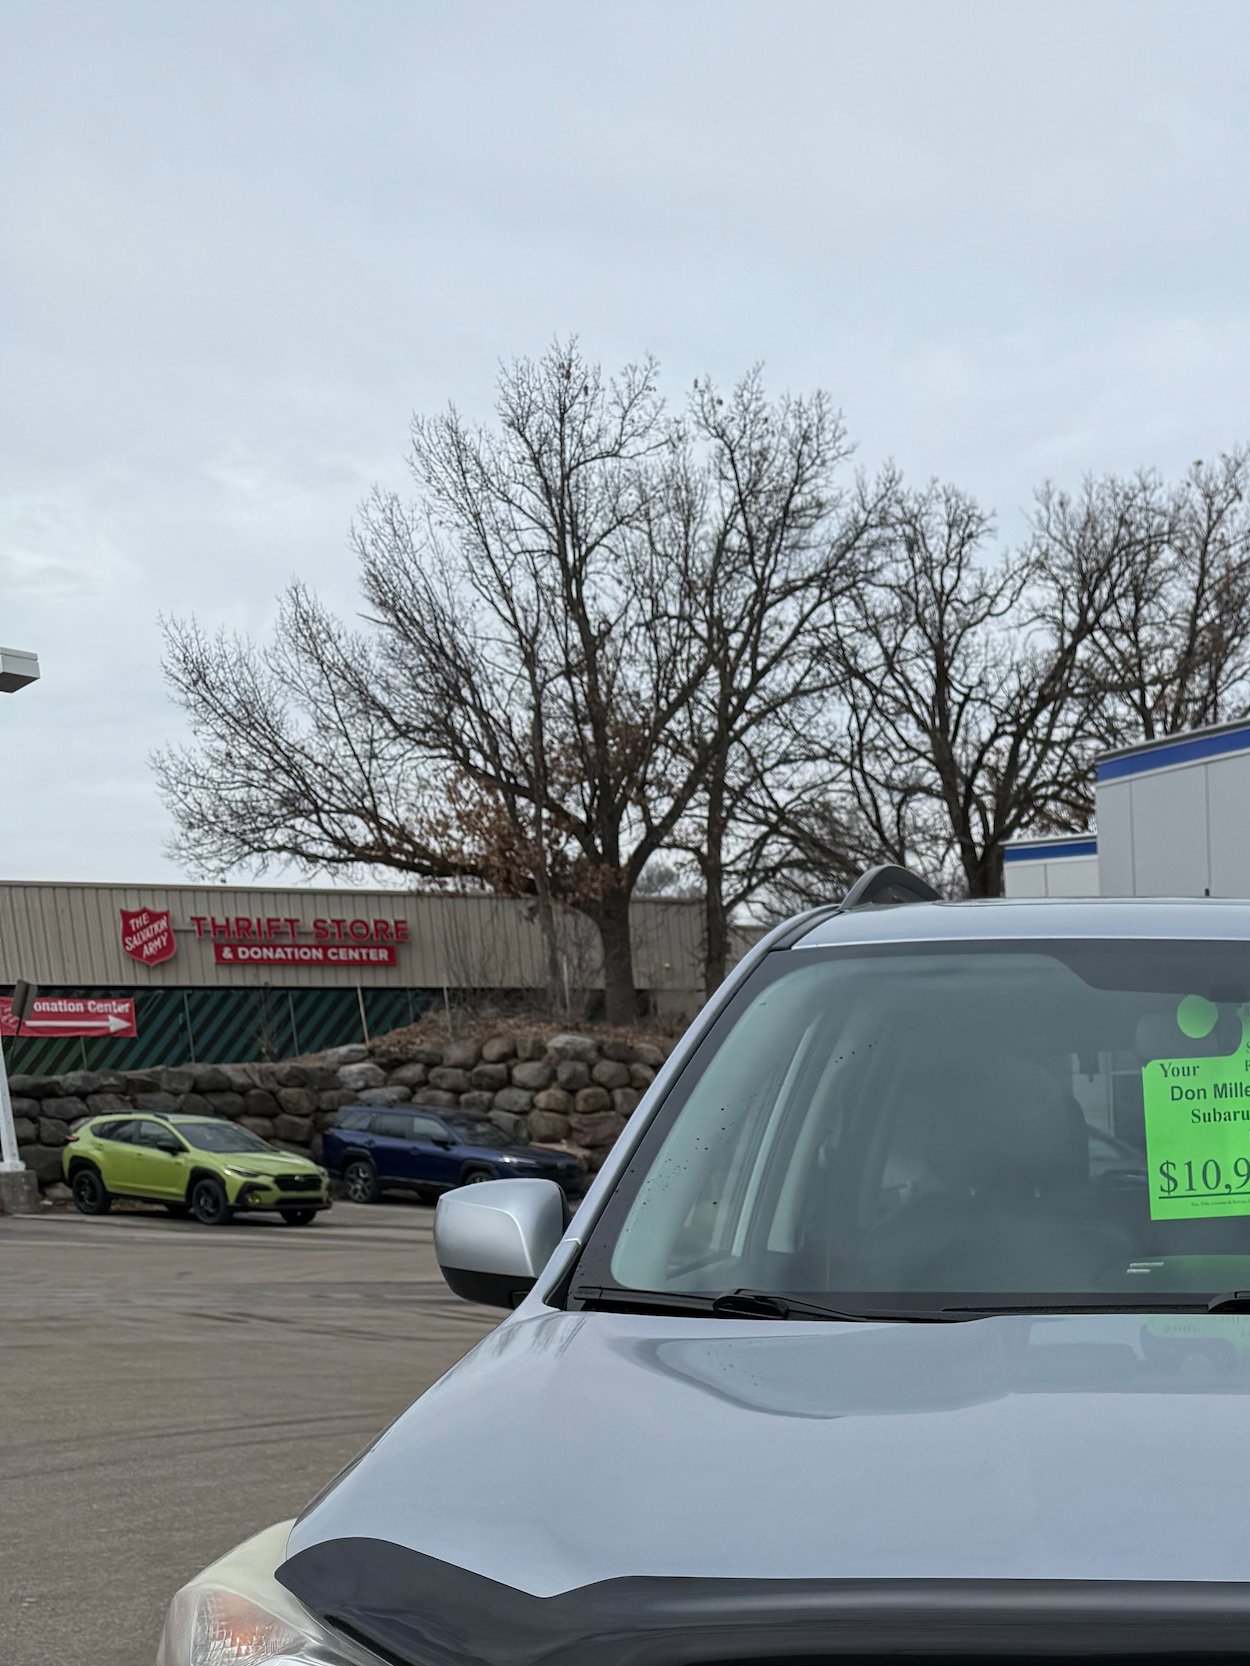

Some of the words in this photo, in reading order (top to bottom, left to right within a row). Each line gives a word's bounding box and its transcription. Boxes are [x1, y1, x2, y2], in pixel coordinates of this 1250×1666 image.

[129, 912, 149, 931] THE
[190, 916, 300, 941] THRIFT
[312, 918, 410, 942] STORE
[142, 931, 168, 958] ARMY
[222, 947, 233, 959] &
[237, 947, 323, 961] DONATION
[327, 947, 389, 961] CENTER
[33, 1000, 84, 1012] onation
[88, 1000, 130, 1013] Center
[1159, 1063, 1200, 1078] Your
[1170, 1085, 1207, 1101] Don
[1191, 1108, 1250, 1123] Subaru
